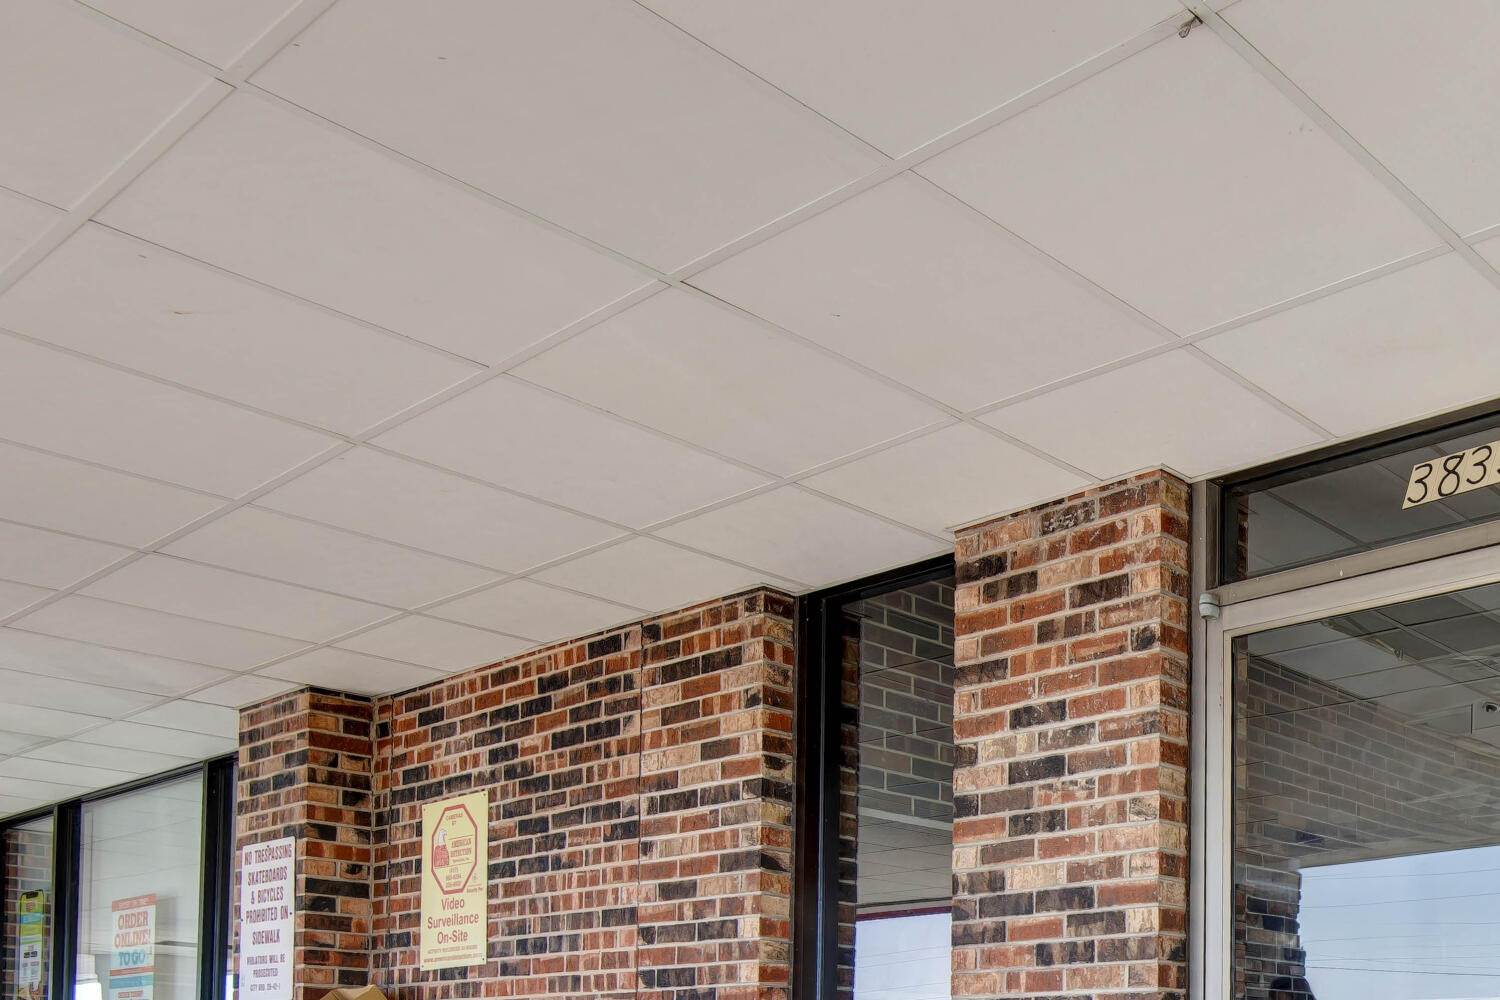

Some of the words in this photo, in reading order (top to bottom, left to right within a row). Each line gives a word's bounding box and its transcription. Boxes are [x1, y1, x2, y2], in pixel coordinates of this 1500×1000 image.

[244, 851, 252, 866] NO
[255, 843, 292, 864] TRESPASSING
[247, 866, 288, 886] SKATEBOARDS
[250, 890, 255, 905] &
[257, 886, 284, 904] BICYCLES
[441, 897, 465, 911] Video
[117, 910, 149, 930] ORDER
[246, 906, 278, 925] PROHIBITED
[281, 905, 289, 920] ON
[427, 913, 479, 929] Surveillance
[114, 929, 151, 949] ONLINE!
[252, 929, 281, 946] SIDEWALK
[437, 929, 468, 945] On-Site
[118, 951, 131, 966] TO
[132, 949, 146, 965] GO
